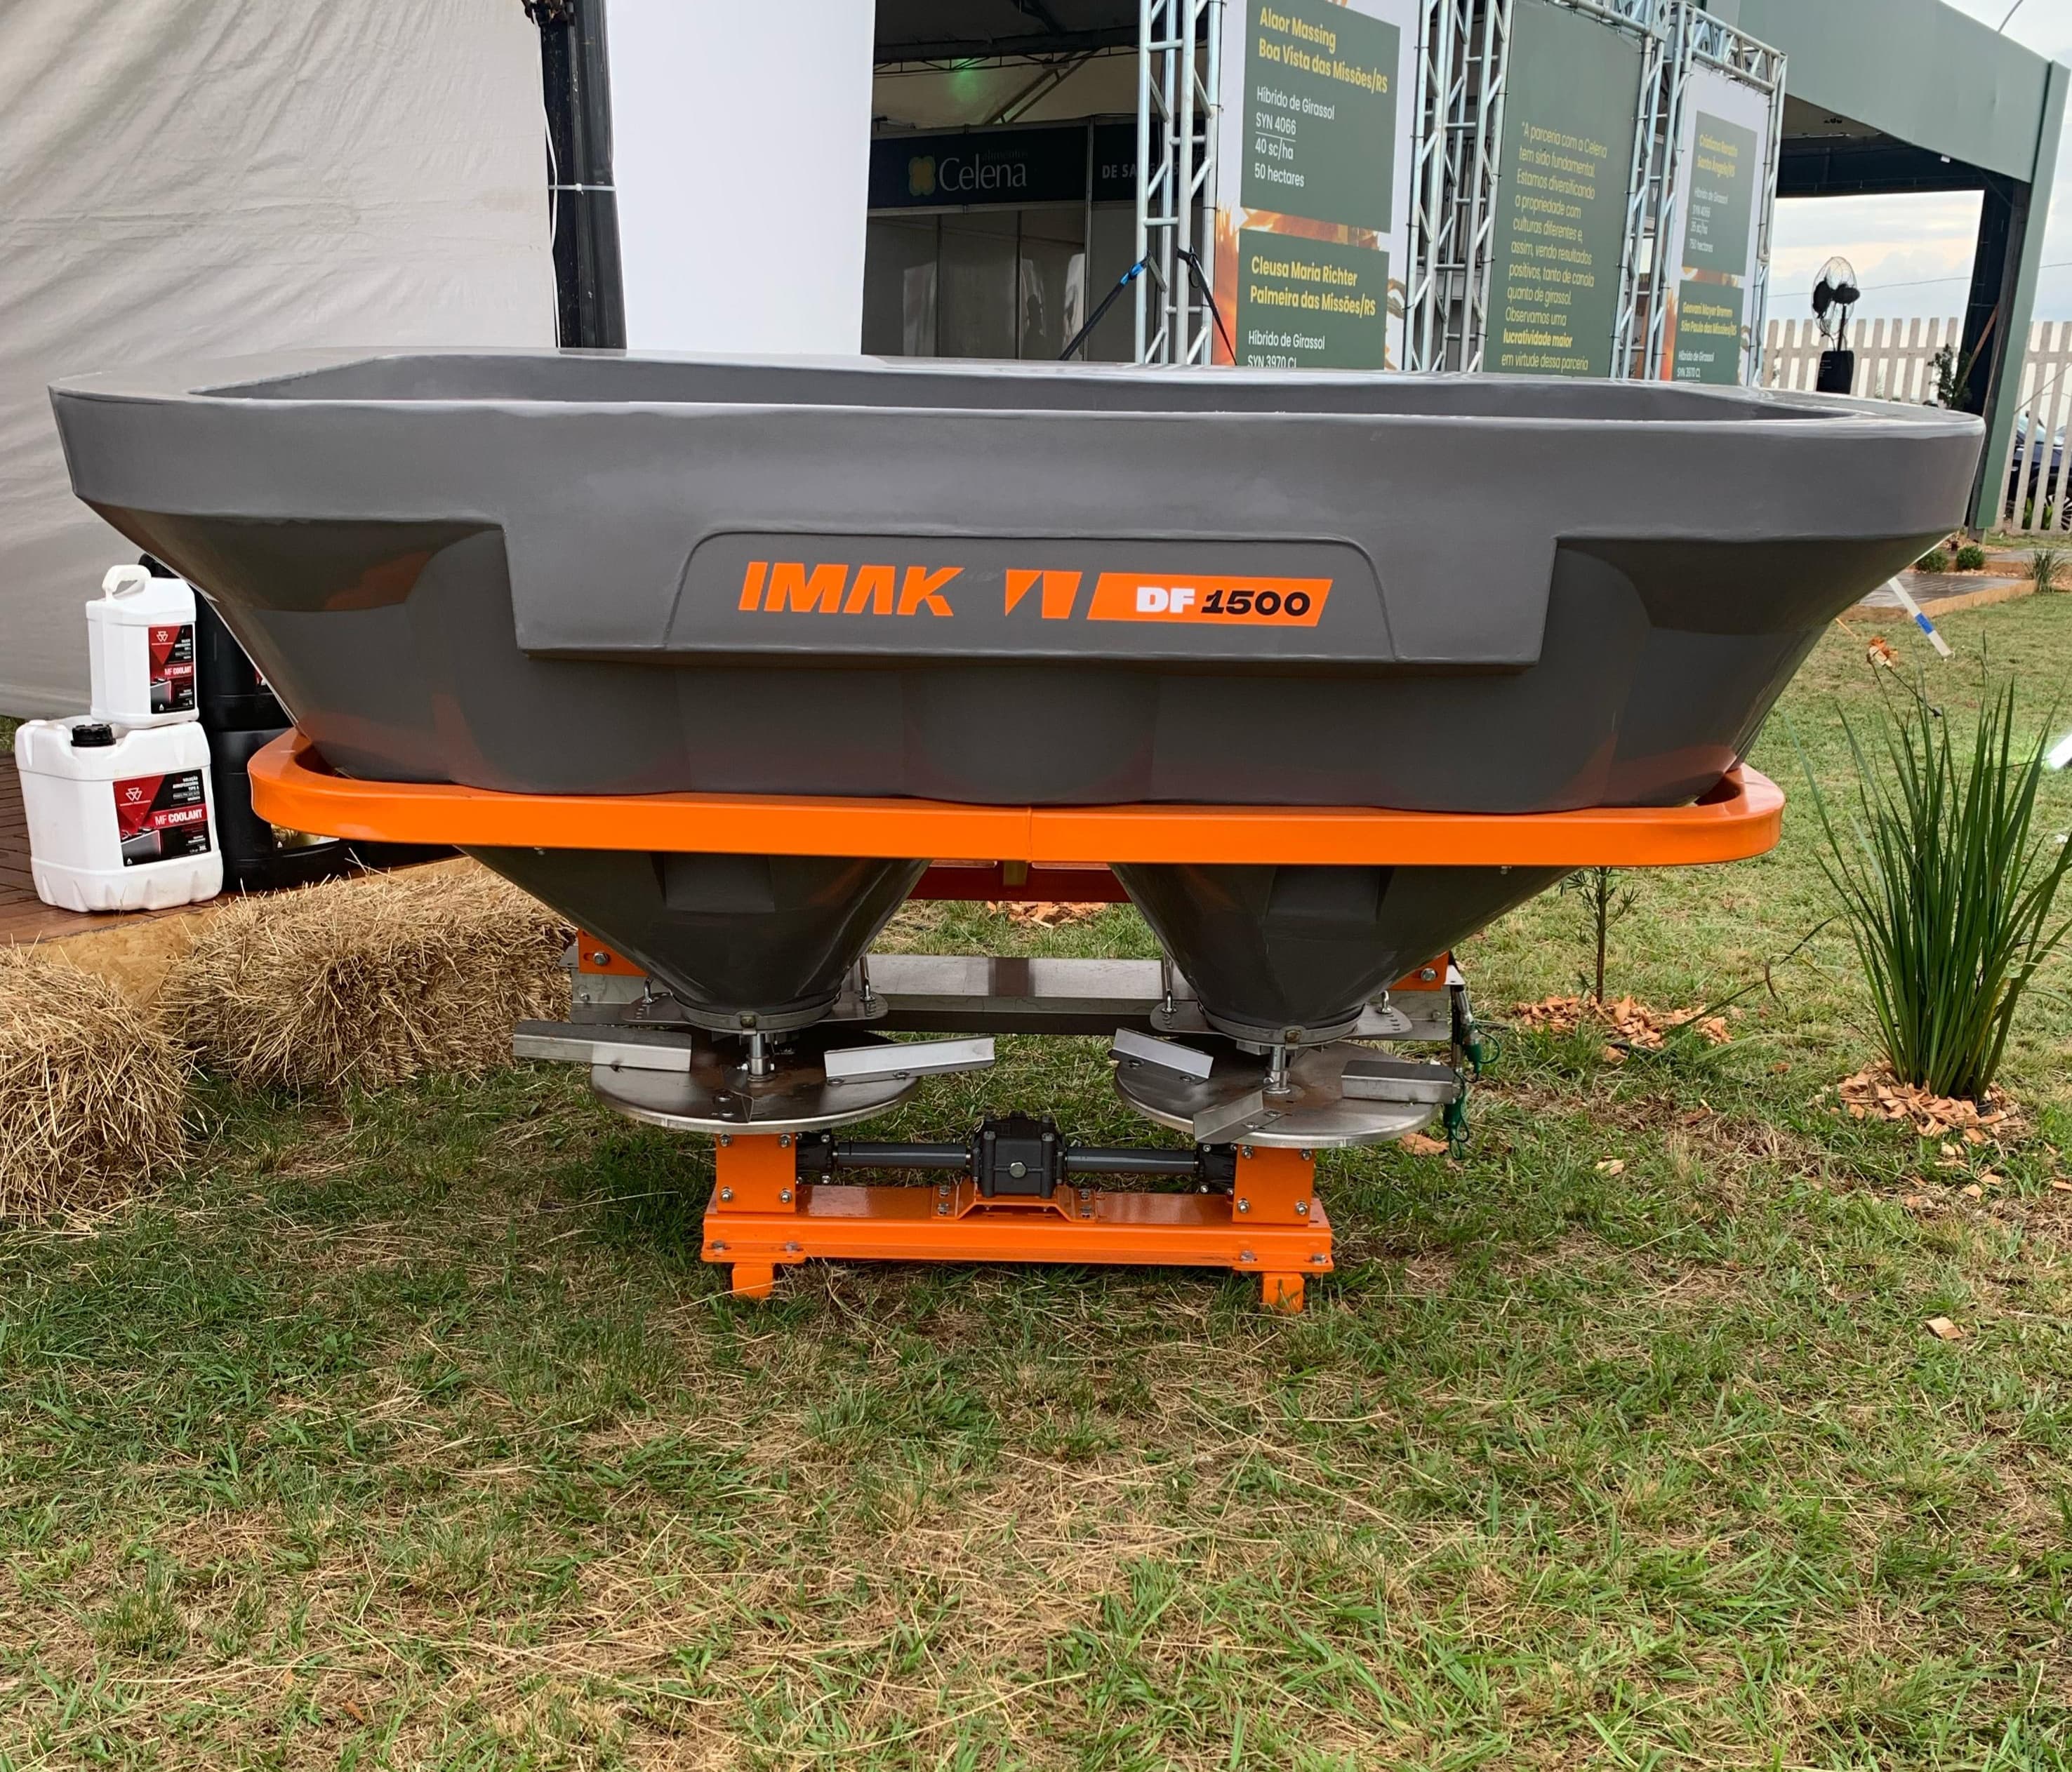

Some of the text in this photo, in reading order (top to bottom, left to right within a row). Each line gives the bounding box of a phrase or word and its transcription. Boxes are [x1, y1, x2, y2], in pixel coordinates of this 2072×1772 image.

[1260, 7, 1336, 54] Alaor Massing
[1259, 38, 1388, 94] Boa Vista das Missões/RS
[1257, 86, 1335, 119] Híbrido de Girassol
[1256, 112, 1296, 135] SYN 4066
[1255, 138, 1293, 160] 40 sc/ha
[1530, 126, 1560, 145] parceria
[1562, 135, 1577, 149] com
[1578, 140, 1583, 152] a
[1585, 138, 1607, 159] Celena
[1519, 145, 1534, 161] tem
[1536, 148, 1550, 166] sido
[939, 153, 1027, 191] Celena
[1102, 165, 1117, 178] DE
[1255, 163, 1304, 187] 50 hectares
[1517, 168, 1595, 199] Estamos diversificando
[1515, 194, 1581, 219] a propriedade com
[1513, 215, 1542, 234] culturas
[1543, 220, 1576, 240] diferentes
[1511, 239, 1592, 265] assim, vendo resultados
[1251, 255, 1357, 286] Cleusa Maria Richter
[1509, 261, 1595, 287] positivos, tanto de canola
[1251, 285, 1376, 319] Palmeira das Missões/RS
[1507, 286, 1533, 303] quanto
[1534, 286, 1544, 302] de
[1506, 306, 1567, 326] Observamos uma
[1249, 330, 1325, 349] Híbrido de Girassol
[1503, 328, 1572, 348] lucratividade maior
[1248, 354, 1263, 368] SYN
[1266, 355, 1286, 368] 3970
[1502, 351, 1588, 373] em virtude dessa parceria
[738, 561, 1310, 616] IMAK DF 1500
[173, 666, 192, 675] COOLANT
[154, 809, 202, 825] MF COOLANT
